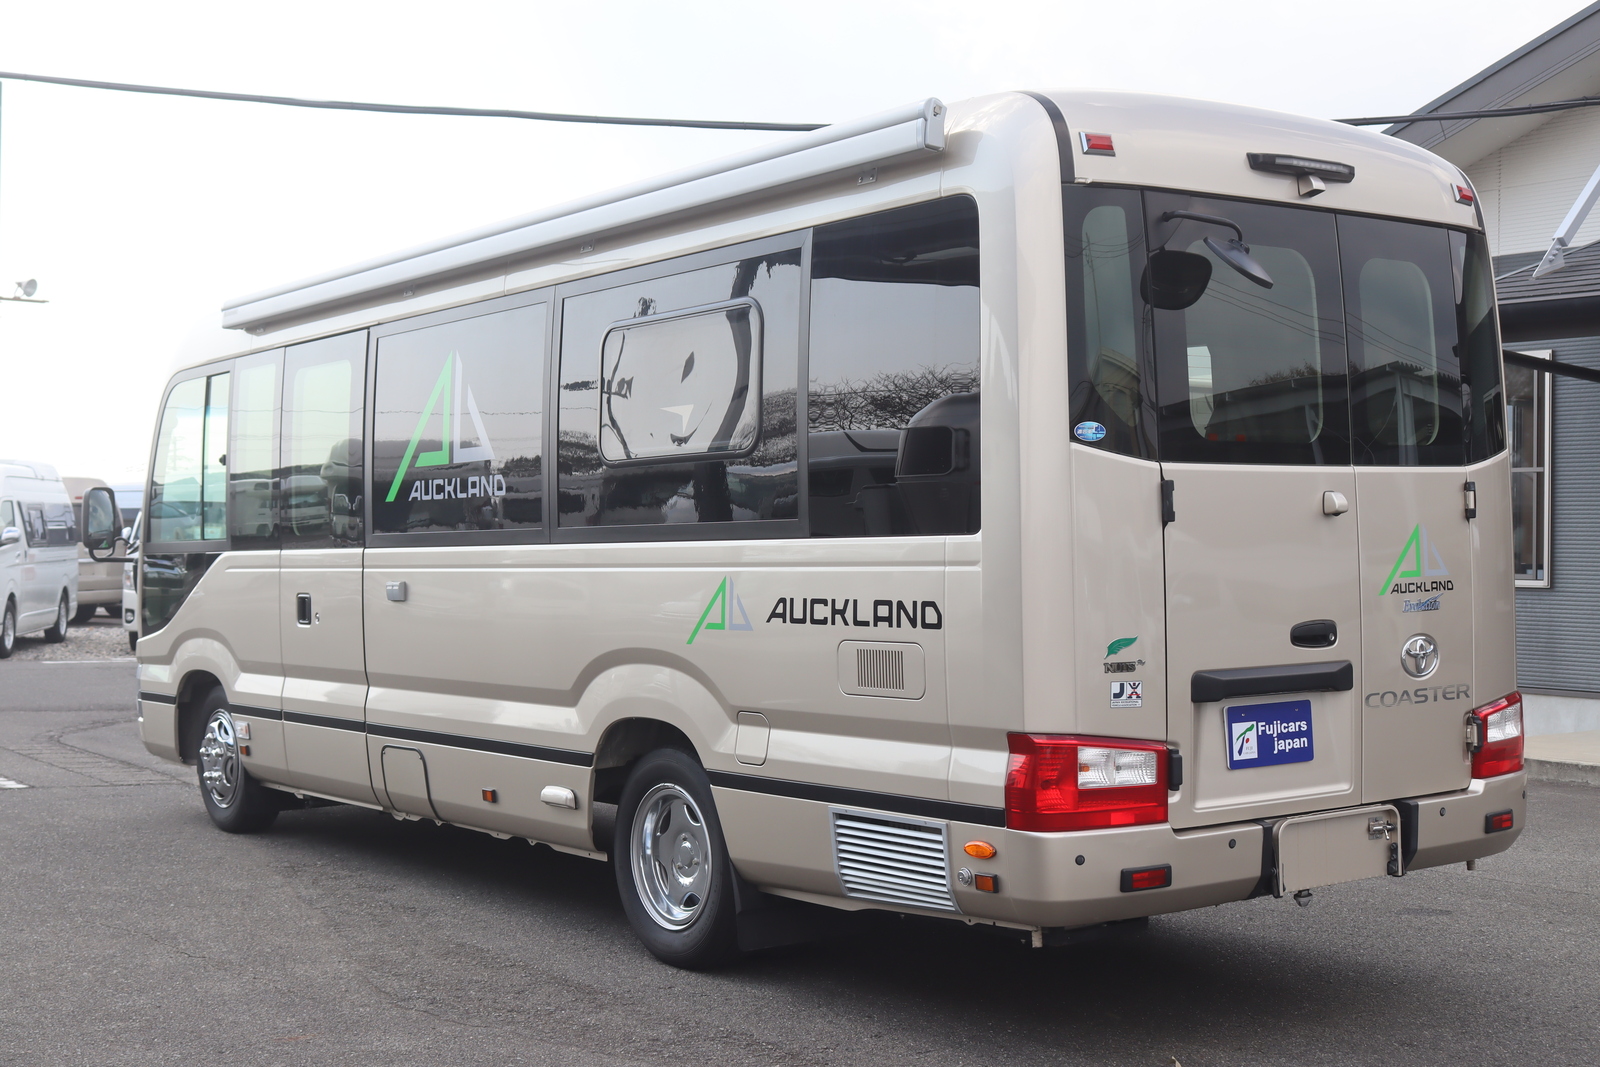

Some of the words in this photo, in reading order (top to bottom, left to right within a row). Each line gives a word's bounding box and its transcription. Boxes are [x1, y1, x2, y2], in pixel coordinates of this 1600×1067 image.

[408, 475, 507, 502] AUCKLAND
[1390, 580, 1455, 595] AUCKLAND
[766, 597, 943, 630] AUCKLAND
[1365, 684, 1470, 708] COASTER
[1258, 720, 1308, 737] Fujicars
[1273, 736, 1308, 754] japan
